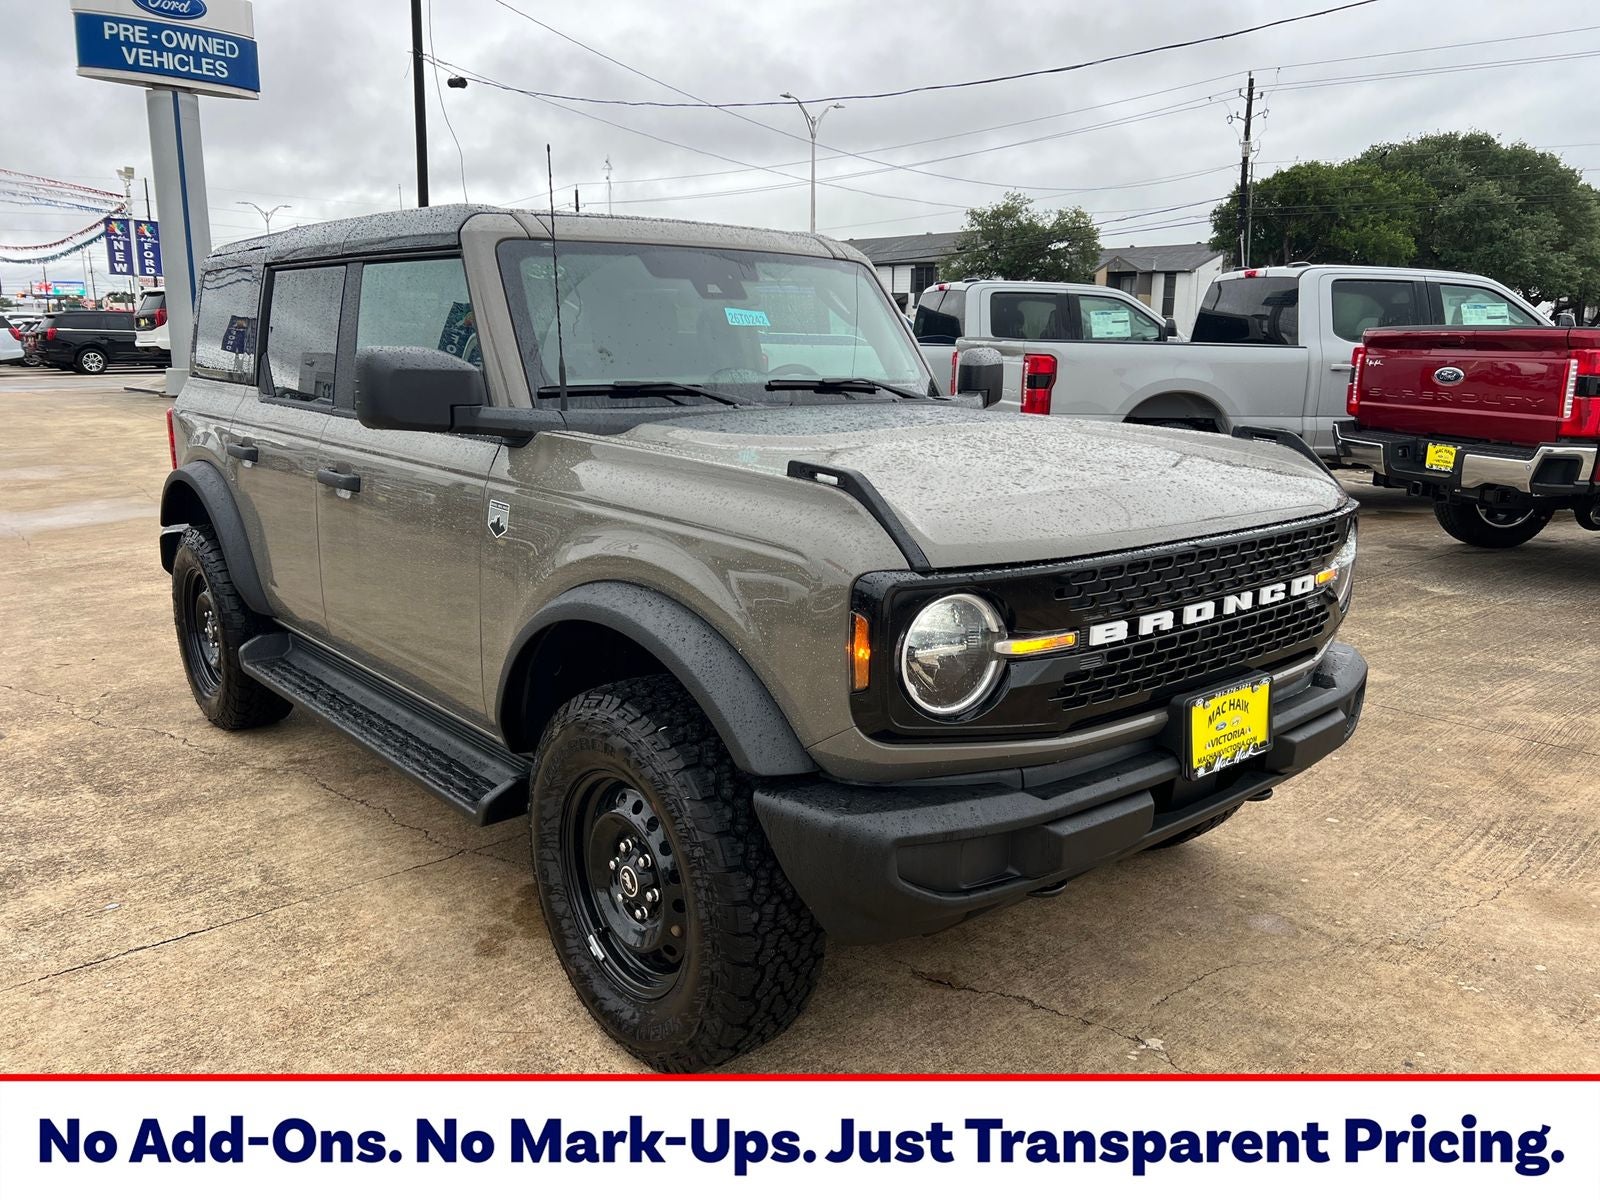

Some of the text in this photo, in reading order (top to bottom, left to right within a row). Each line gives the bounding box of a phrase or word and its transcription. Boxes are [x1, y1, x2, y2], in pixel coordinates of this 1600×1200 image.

[103, 21, 239, 58] PRE-OWNED
[121, 46, 229, 78] VEHICLES
[113, 240, 128, 273] NEW
[143, 242, 156, 275] FORD
[1088, 574, 1315, 647] BRONCO
[1208, 701, 1227, 728] MAC
[1228, 698, 1250, 715] HAIK
[1210, 727, 1246, 748] VICTORIA
